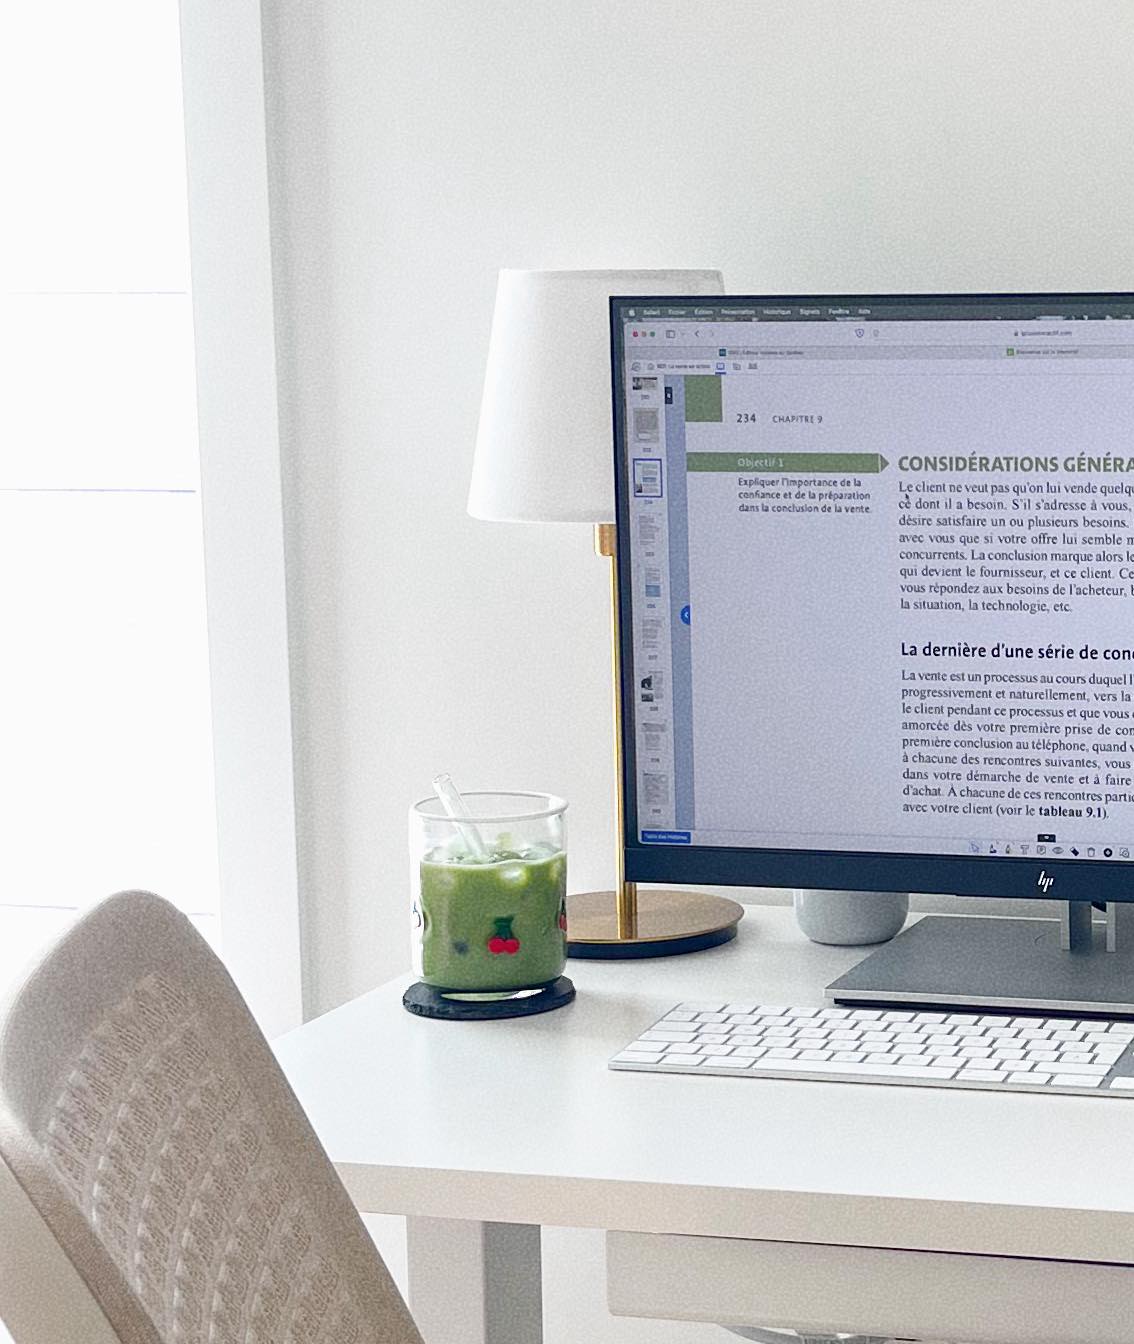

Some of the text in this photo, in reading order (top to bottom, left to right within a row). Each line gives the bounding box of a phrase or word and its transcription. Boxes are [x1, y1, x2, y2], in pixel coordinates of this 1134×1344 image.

[736, 414, 756, 422] 234
[772, 415, 822, 423] CHAPITRE 9
[737, 456, 776, 468] Objectif
[898, 451, 1058, 471] CONSIDÉRATIONS
[738, 477, 779, 488] Expliquer
[840, 477, 850, 486] de
[853, 477, 861, 486] la
[915, 480, 946, 492] client
[1063, 480, 1097, 493] vende
[738, 489, 780, 498] confiance
[794, 490, 805, 499] de
[808, 490, 816, 499] la
[818, 490, 870, 502] préparation
[738, 503, 759, 512] dans
[761, 503, 769, 512] la
[771, 503, 818, 512] conclusion
[820, 503, 831, 512] de
[834, 503, 842, 512] la
[898, 513, 932, 526] désire
[936, 513, 986, 526] satisfaire
[1027, 514, 1078, 531] plusieurs
[997, 533, 1026, 544] votre
[1030, 531, 1057, 544] offre
[1081, 532, 1122, 544] semble
[987, 548, 1047, 561] conclusion
[1050, 553, 1093, 565] marque
[1095, 548, 1123, 561] alors
[921, 564, 961, 576] devient
[928, 580, 980, 597] répondez
[1006, 581, 1049, 594] besoins
[901, 641, 917, 656] La
[922, 641, 986, 657] dernière
[1037, 643, 1074, 658] série
[1078, 644, 1098, 659] de
[917, 670, 947, 681] vente
[983, 674, 1038, 687] processus
[1055, 675, 1086, 684] cours
[1088, 671, 1126, 688] duquel
[901, 684, 992, 702] progressivement
[914, 701, 944, 714] client
[946, 702, 991, 719] pendant
[1009, 708, 1064, 721] processus
[901, 717, 949, 731] amorcée
[976, 721, 1005, 732] votre
[1009, 720, 1060, 737] première
[1064, 721, 1092, 738] prise
[901, 734, 951, 751] première
[953, 735, 1013, 749] conclusion
[1092, 738, 1126, 756] quand
[911, 750, 957, 764] chacune
[983, 754, 1041, 766] rencontres
[933, 770, 961, 780] votre
[966, 768, 1021, 782] démarche
[1043, 773, 1074, 784] vente
[1105, 772, 1131, 785] faire
[959, 784, 1005, 798] chacune
[1043, 789, 1102, 801] rencontres
[930, 801, 1082, 817] votre client tableau
[1037, 870, 1054, 892] hp
